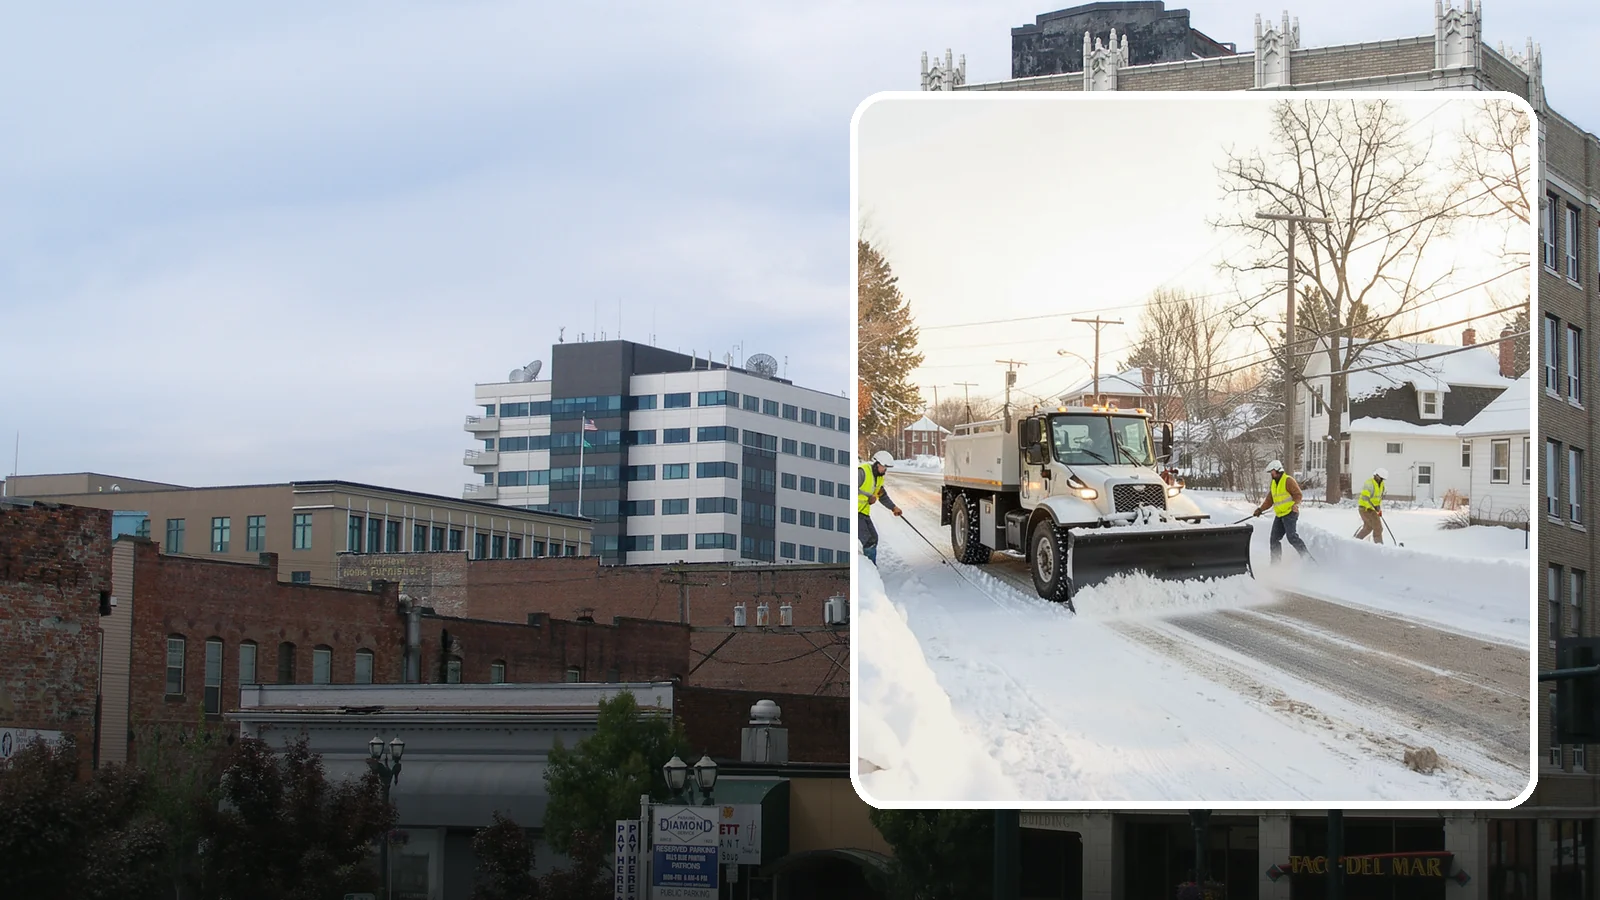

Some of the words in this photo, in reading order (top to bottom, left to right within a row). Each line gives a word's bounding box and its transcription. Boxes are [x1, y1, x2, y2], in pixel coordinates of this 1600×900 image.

[370, 566, 427, 577] Furnishers
[660, 818, 713, 833] DIAMOND
[1022, 815, 1070, 828] BUILDING
[617, 825, 625, 853] PAY
[628, 824, 637, 853] PAY
[656, 845, 688, 853] RESERVED
[689, 846, 716, 854] PARKING
[722, 851, 739, 863] Soup
[1345, 855, 1385, 876] DEL
[1391, 856, 1443, 877] MAR
[616, 856, 625, 894] HERE
[628, 856, 636, 894] HERE
[660, 889, 682, 897] PUBLIC
[683, 890, 710, 899] PARKING
